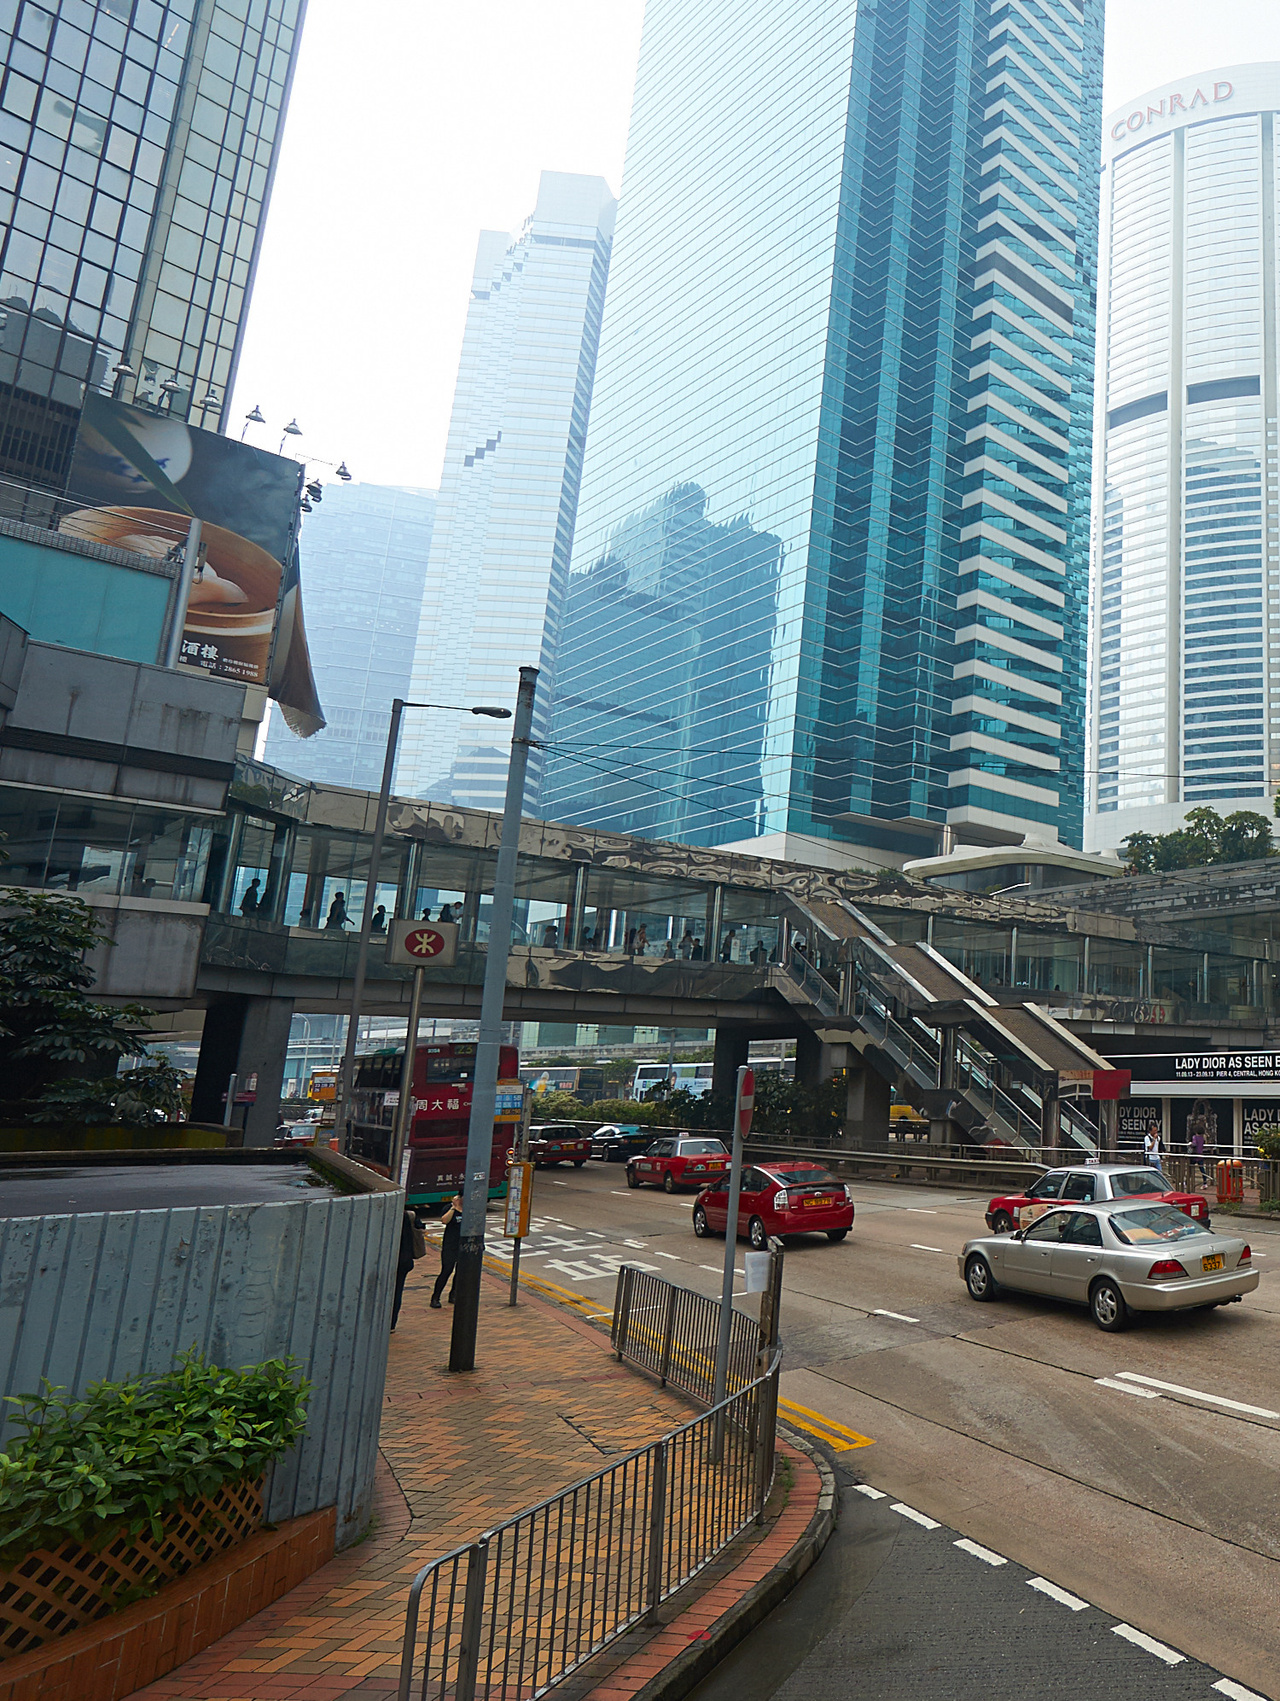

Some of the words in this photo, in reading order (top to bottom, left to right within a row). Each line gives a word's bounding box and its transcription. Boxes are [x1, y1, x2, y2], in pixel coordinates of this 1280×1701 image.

[1110, 81, 1235, 141] CONRAD
[182, 640, 219, 660] 酒樓
[224, 665, 241, 673] 2865
[1175, 1058, 1200, 1070] LADY
[1202, 1057, 1226, 1069] DIOR
[1228, 1056, 1242, 1068] AS
[1244, 1055, 1272, 1068] SEEN
[416, 1098, 459, 1111] 周大福
[1133, 1107, 1157, 1119] DIOR
[1244, 1109, 1275, 1121] LADY
[1121, 1119, 1146, 1131] SEEN
[1244, 1122, 1260, 1135] AS
